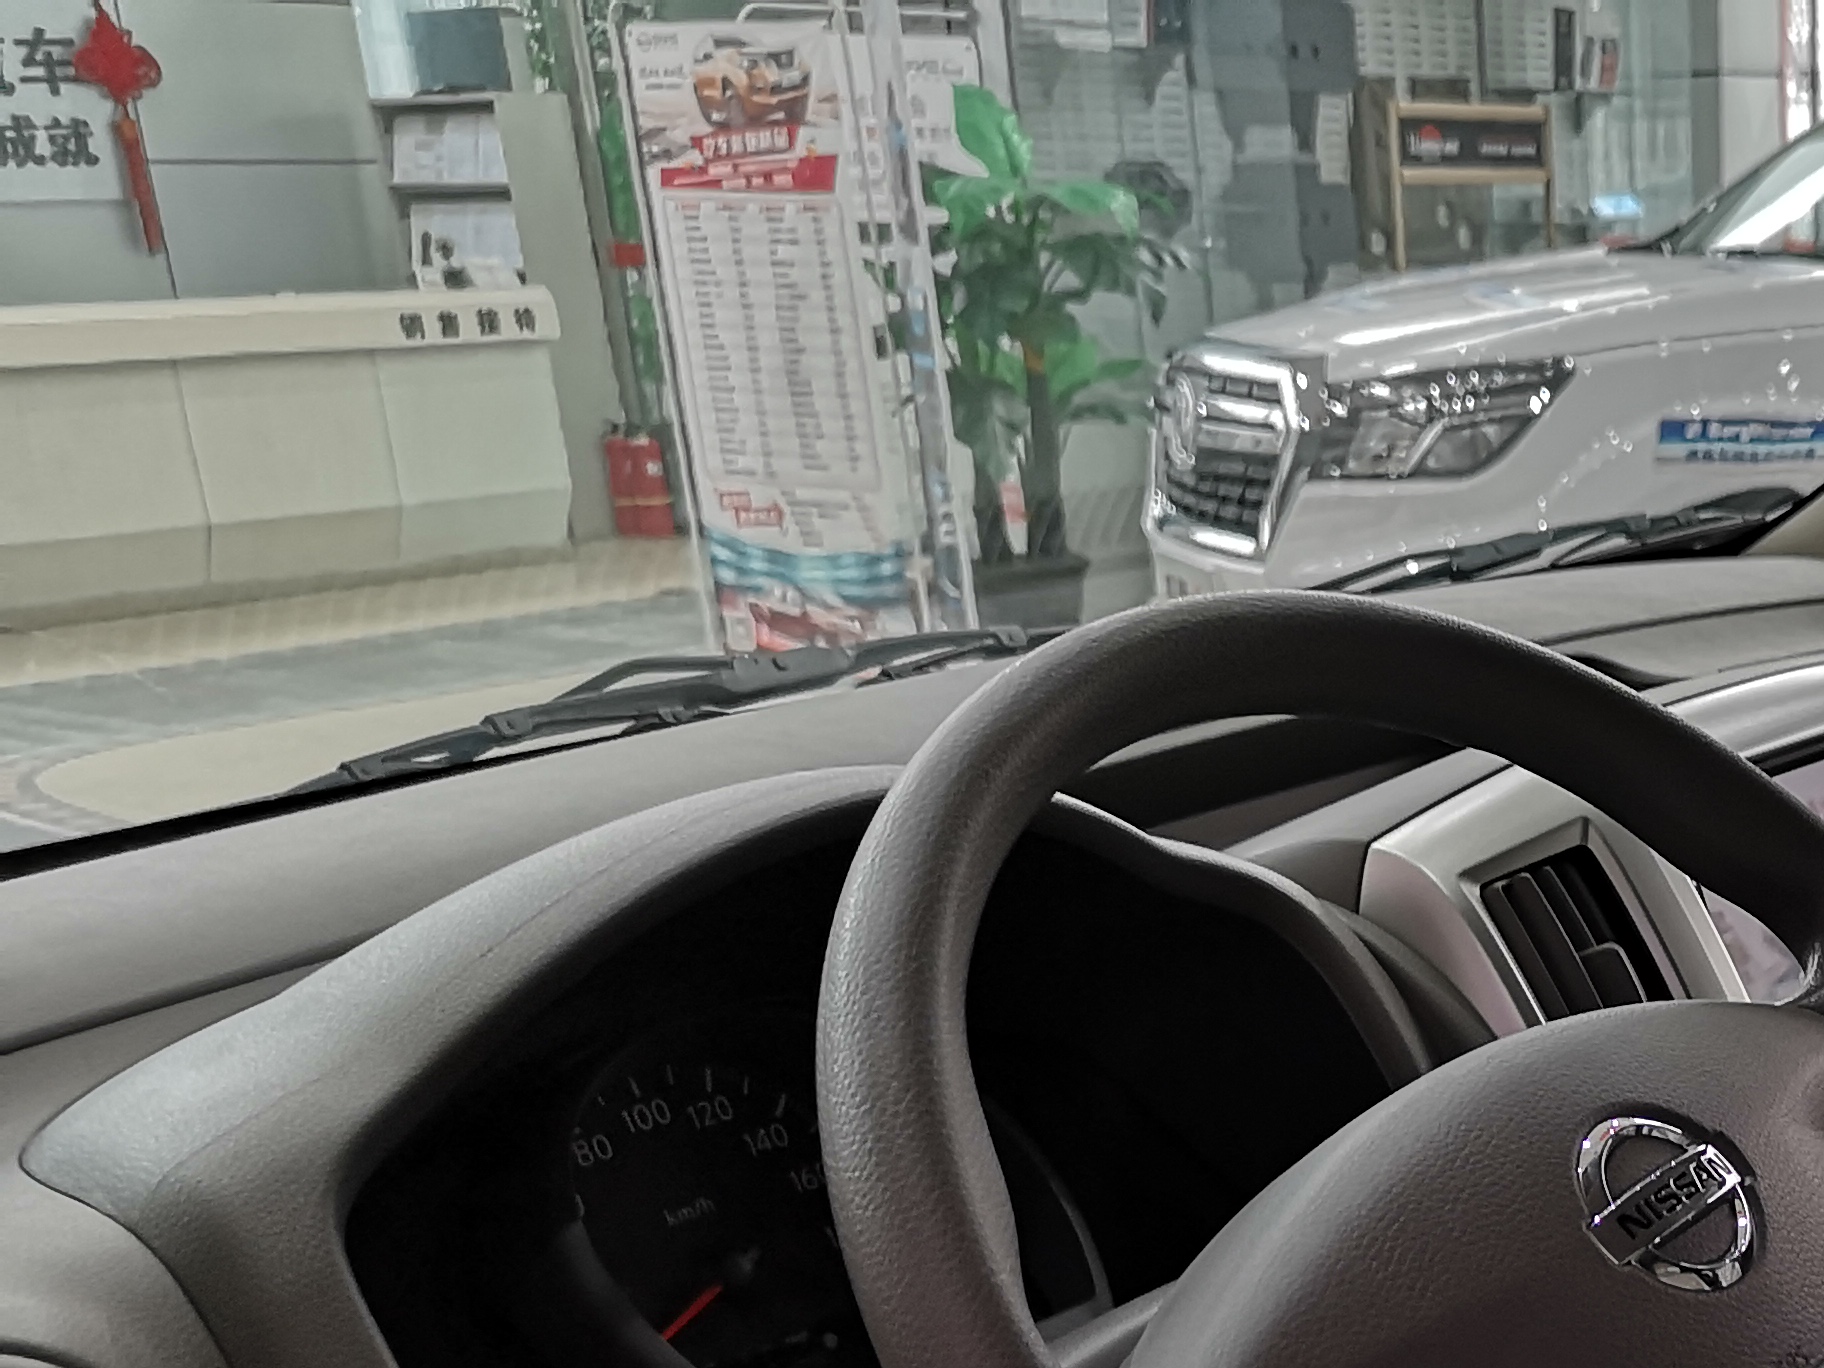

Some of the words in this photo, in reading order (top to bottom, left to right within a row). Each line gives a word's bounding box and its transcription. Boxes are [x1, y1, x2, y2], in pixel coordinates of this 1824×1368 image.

[621, 1098, 672, 1134] 100
[687, 1094, 734, 1130] 120
[572, 1133, 614, 1167] 80
[743, 1123, 789, 1157] 140
[1615, 1147, 1735, 1240] NISSAN
